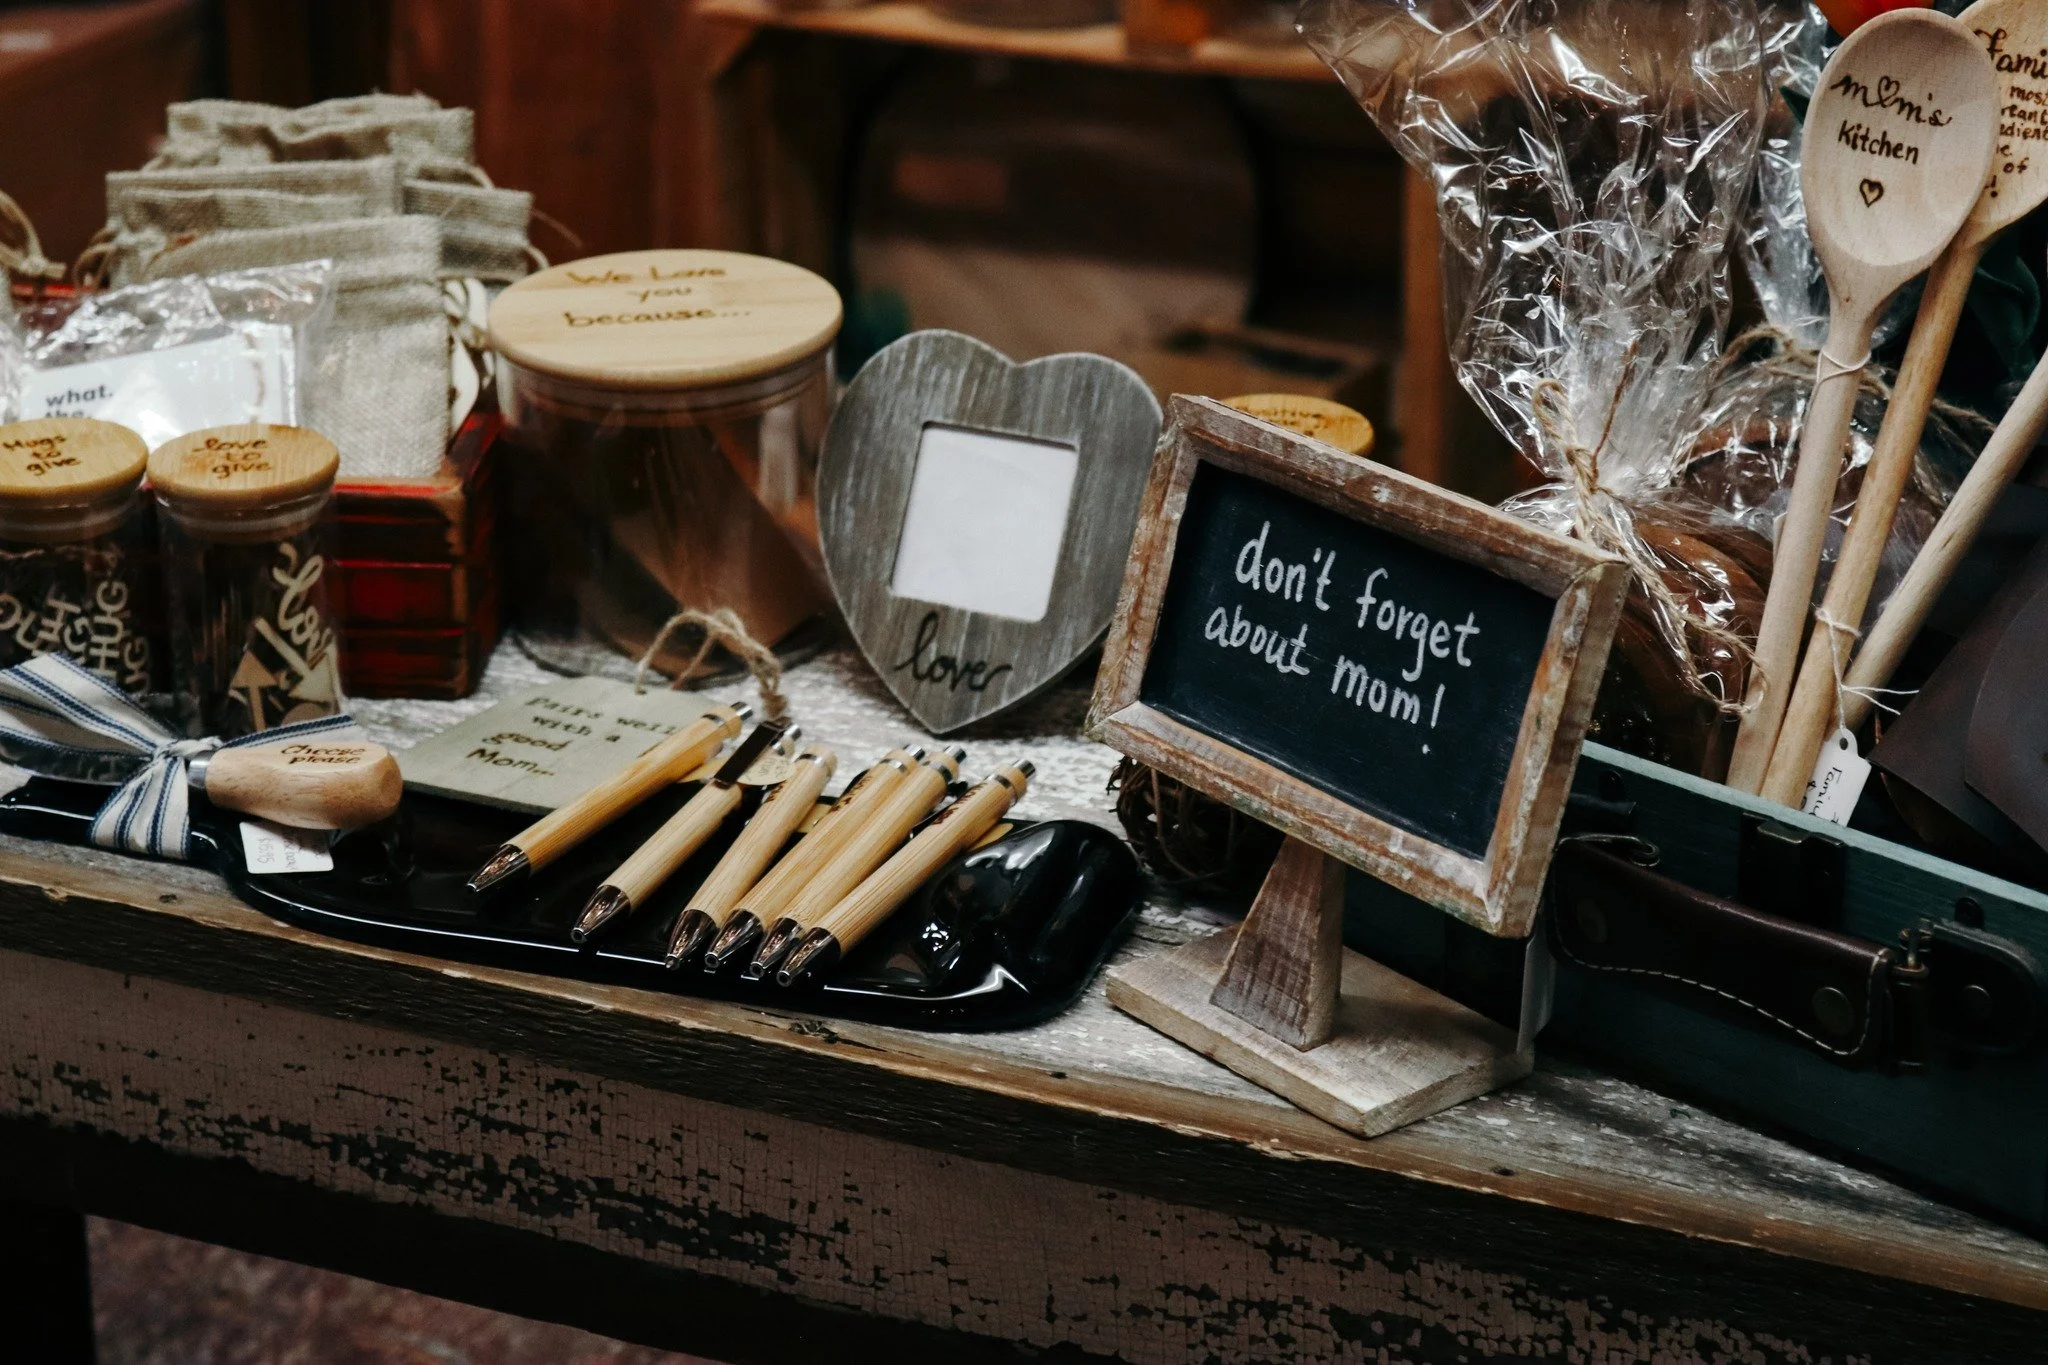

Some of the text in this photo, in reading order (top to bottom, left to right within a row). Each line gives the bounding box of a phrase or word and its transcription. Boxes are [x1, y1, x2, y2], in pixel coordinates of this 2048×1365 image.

[1235, 520, 1481, 682] don't forget
[1204, 604, 1446, 755] about mom!
[481, 733, 574, 752] good
[532, 716, 592, 736] with
